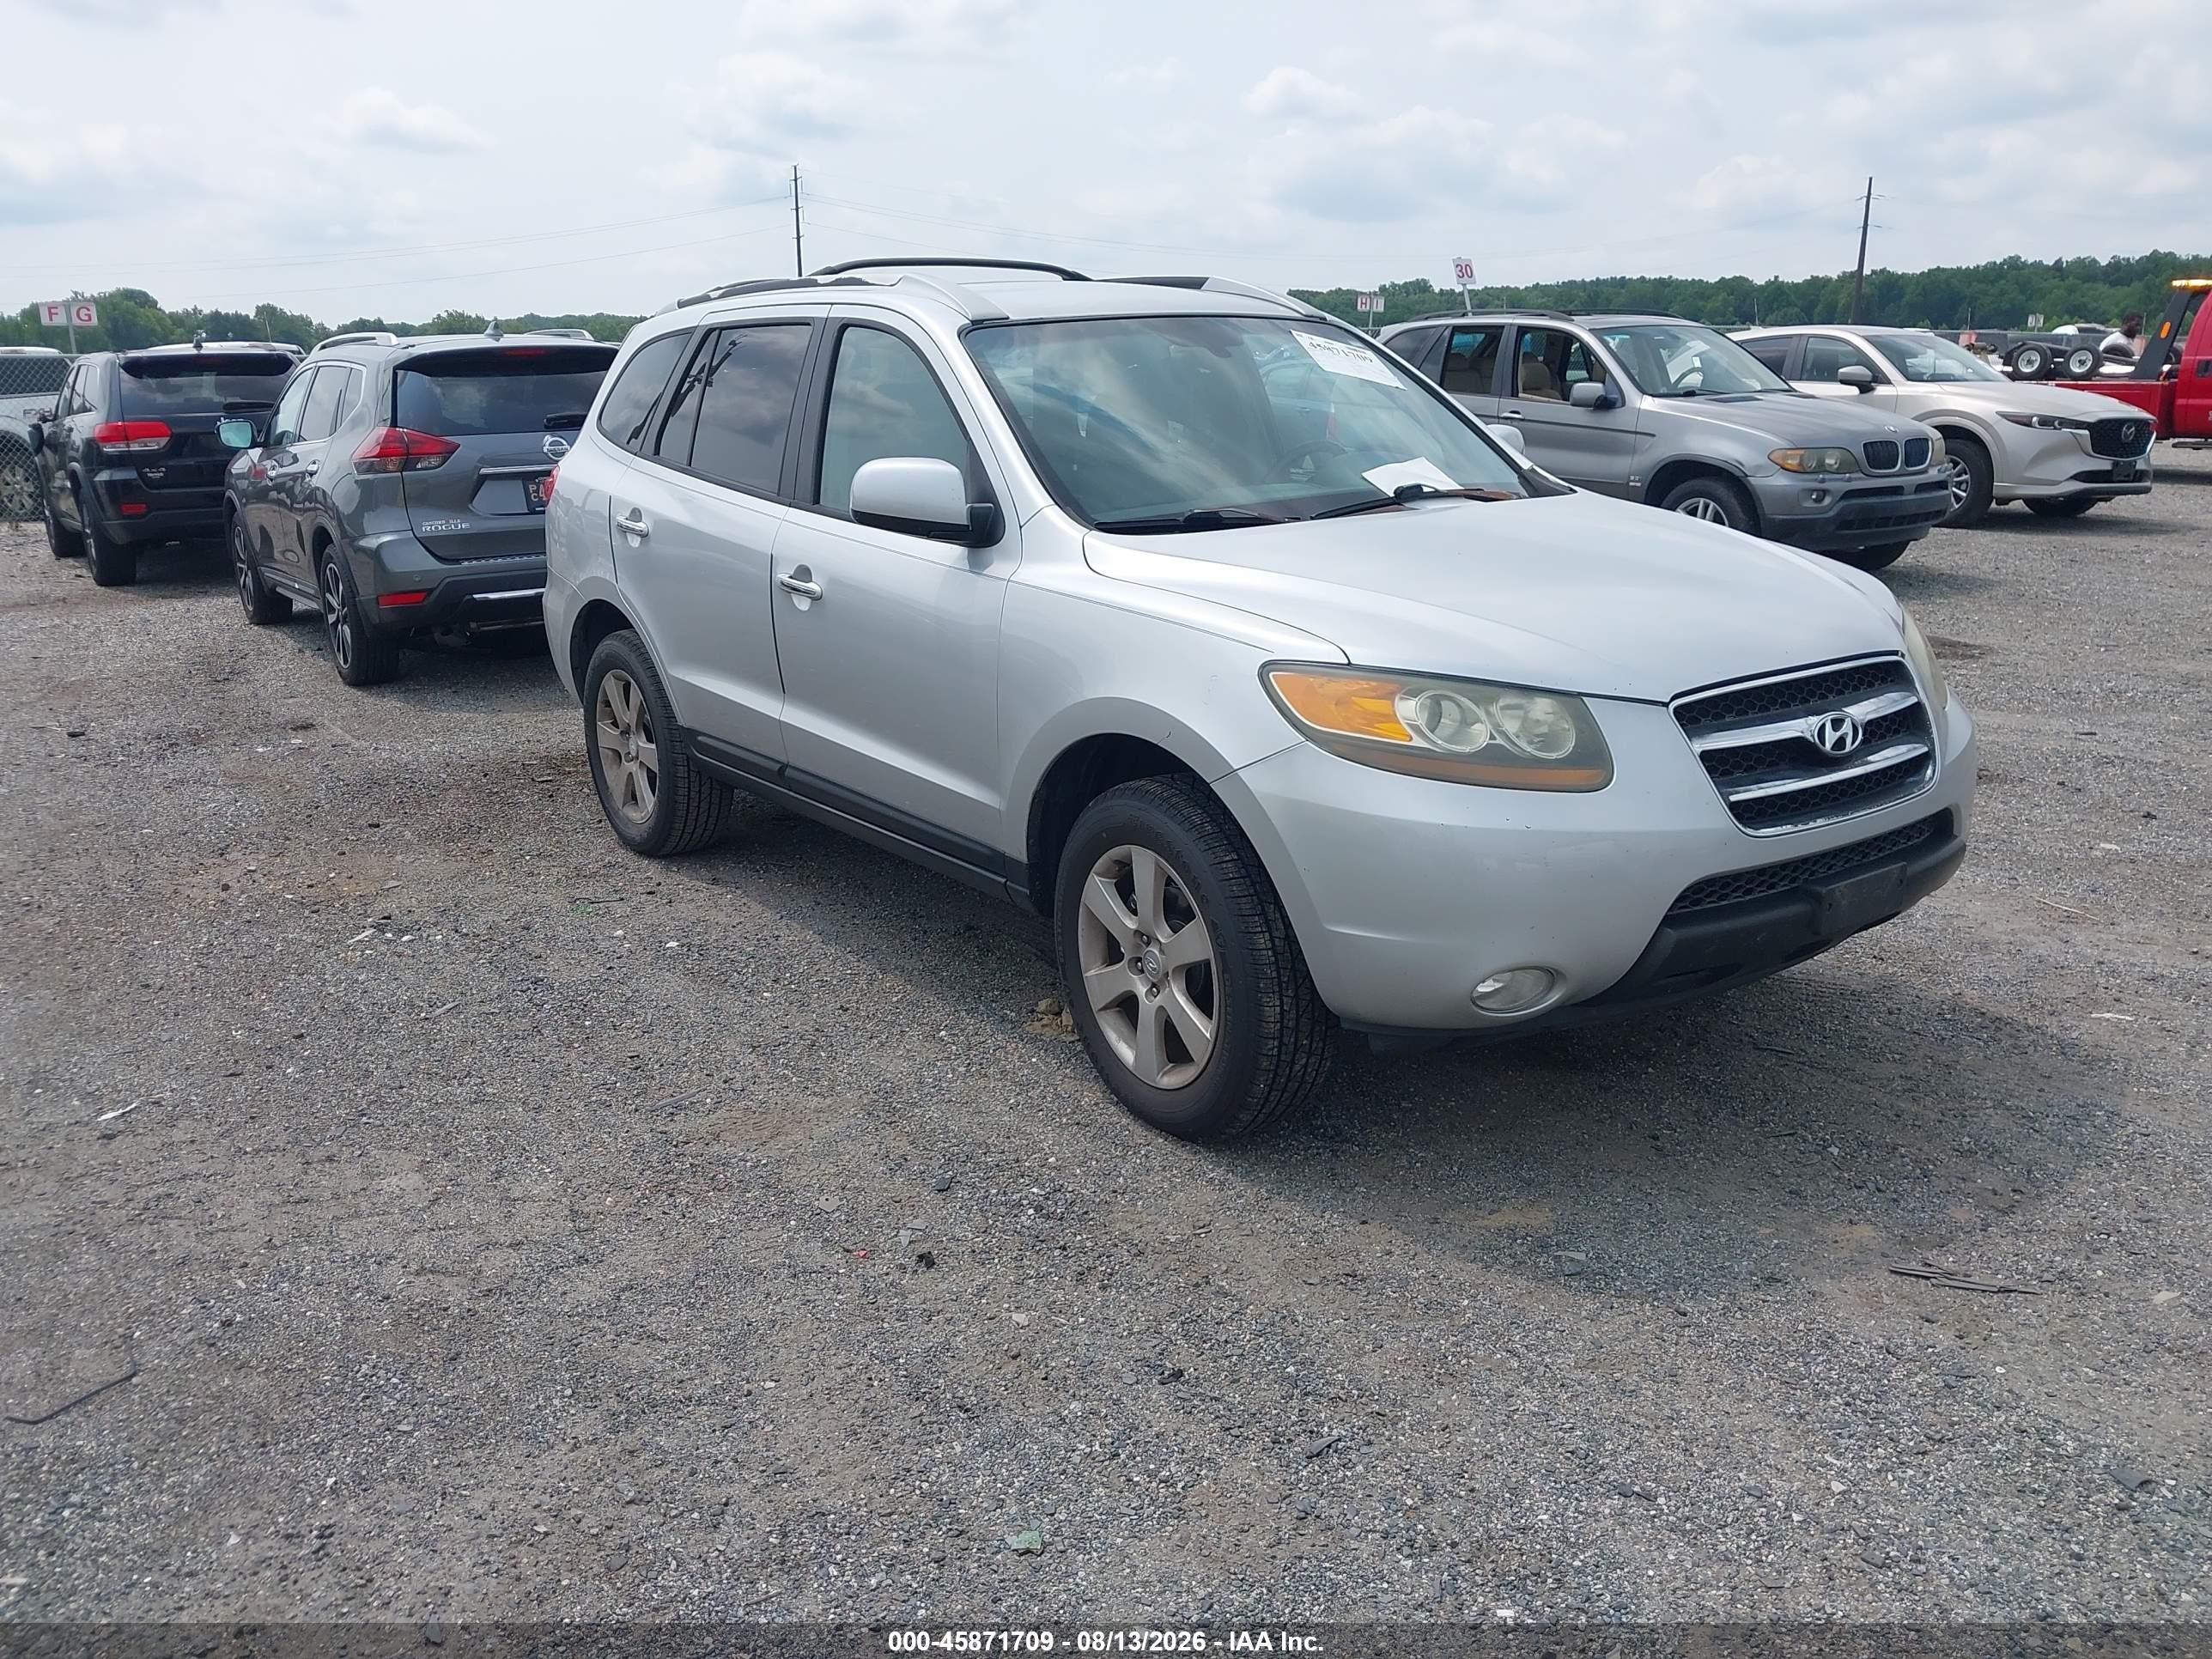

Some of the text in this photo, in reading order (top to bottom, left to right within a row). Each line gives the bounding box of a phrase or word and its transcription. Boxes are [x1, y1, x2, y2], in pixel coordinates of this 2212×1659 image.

[1455, 264, 1474, 279] 30
[1360, 298, 1368, 309] H
[47, 306, 92, 322] F G
[422, 522, 471, 532] ROGUE
